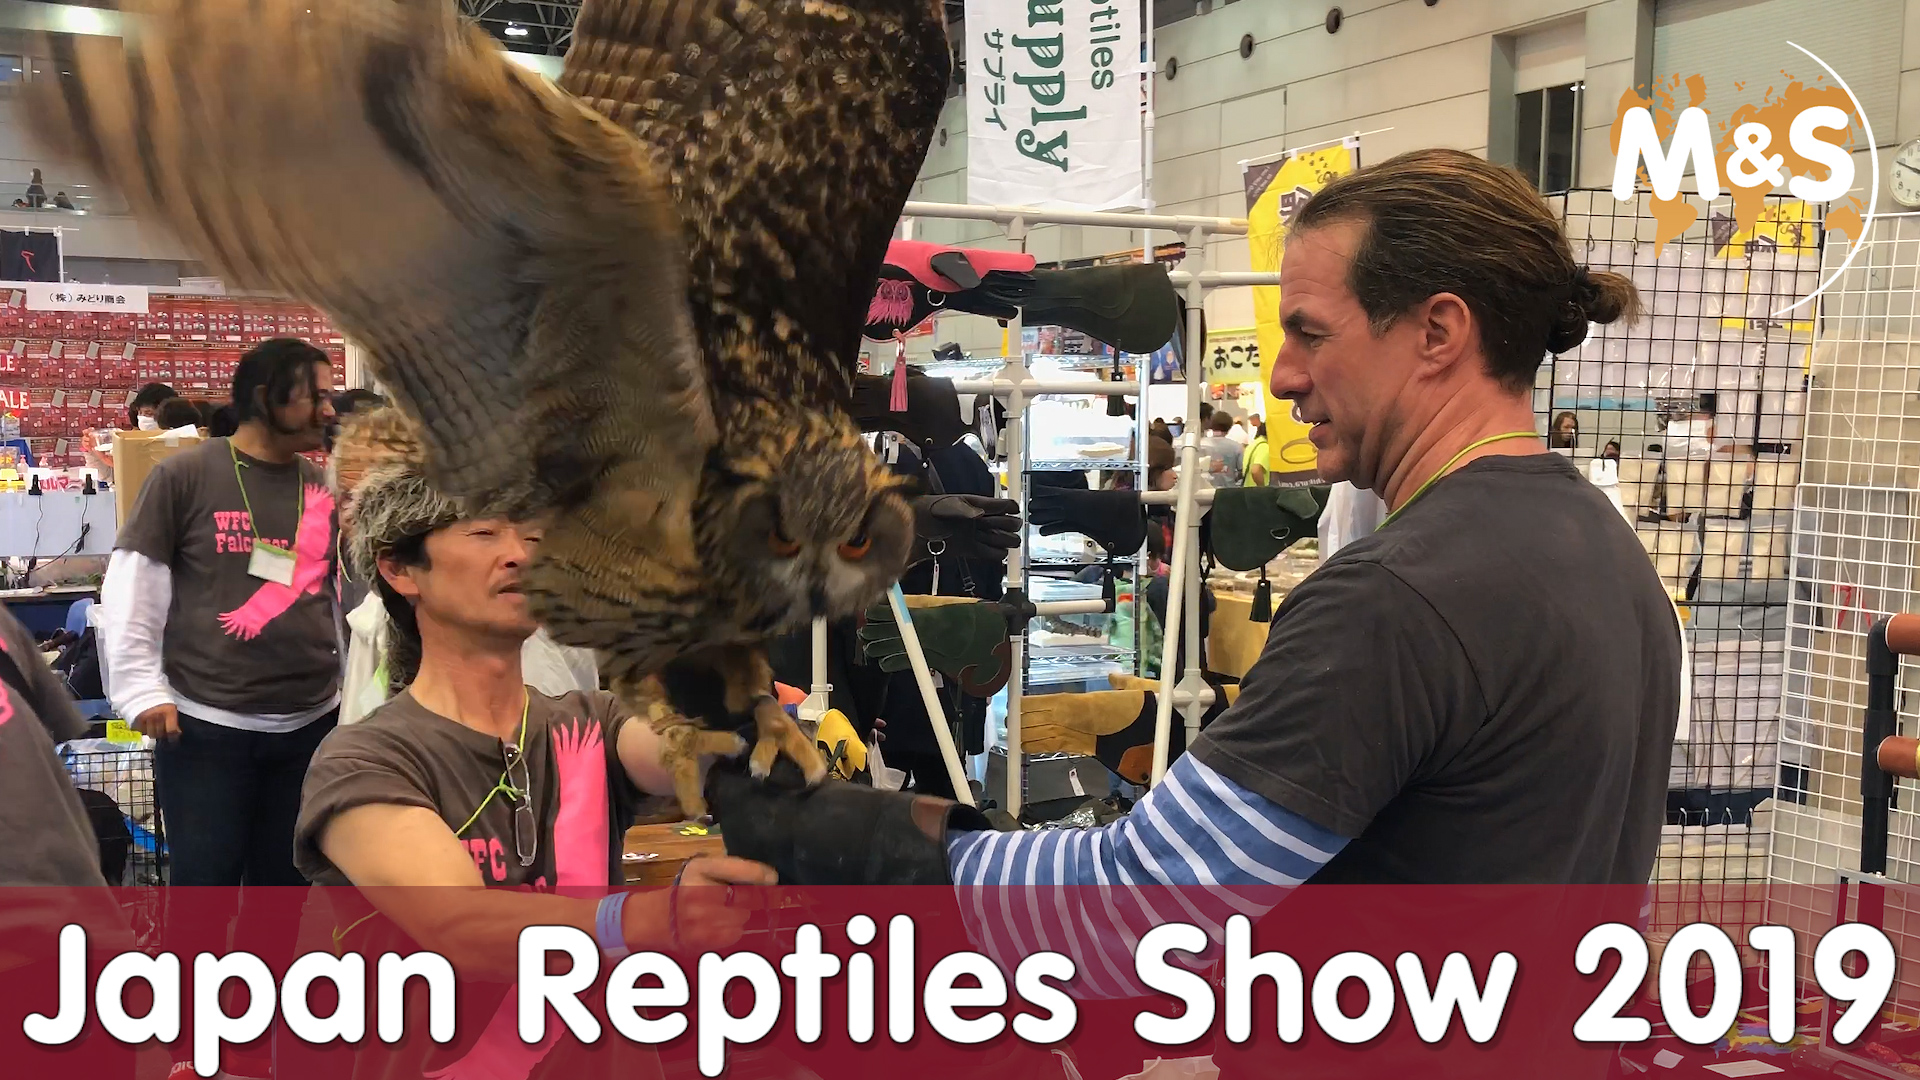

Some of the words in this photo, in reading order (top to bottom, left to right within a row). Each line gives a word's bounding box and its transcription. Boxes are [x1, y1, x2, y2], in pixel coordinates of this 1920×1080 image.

[983, 28, 1008, 131] サプライ
[213, 511, 251, 531] WFC
[460, 837, 507, 882] FC
